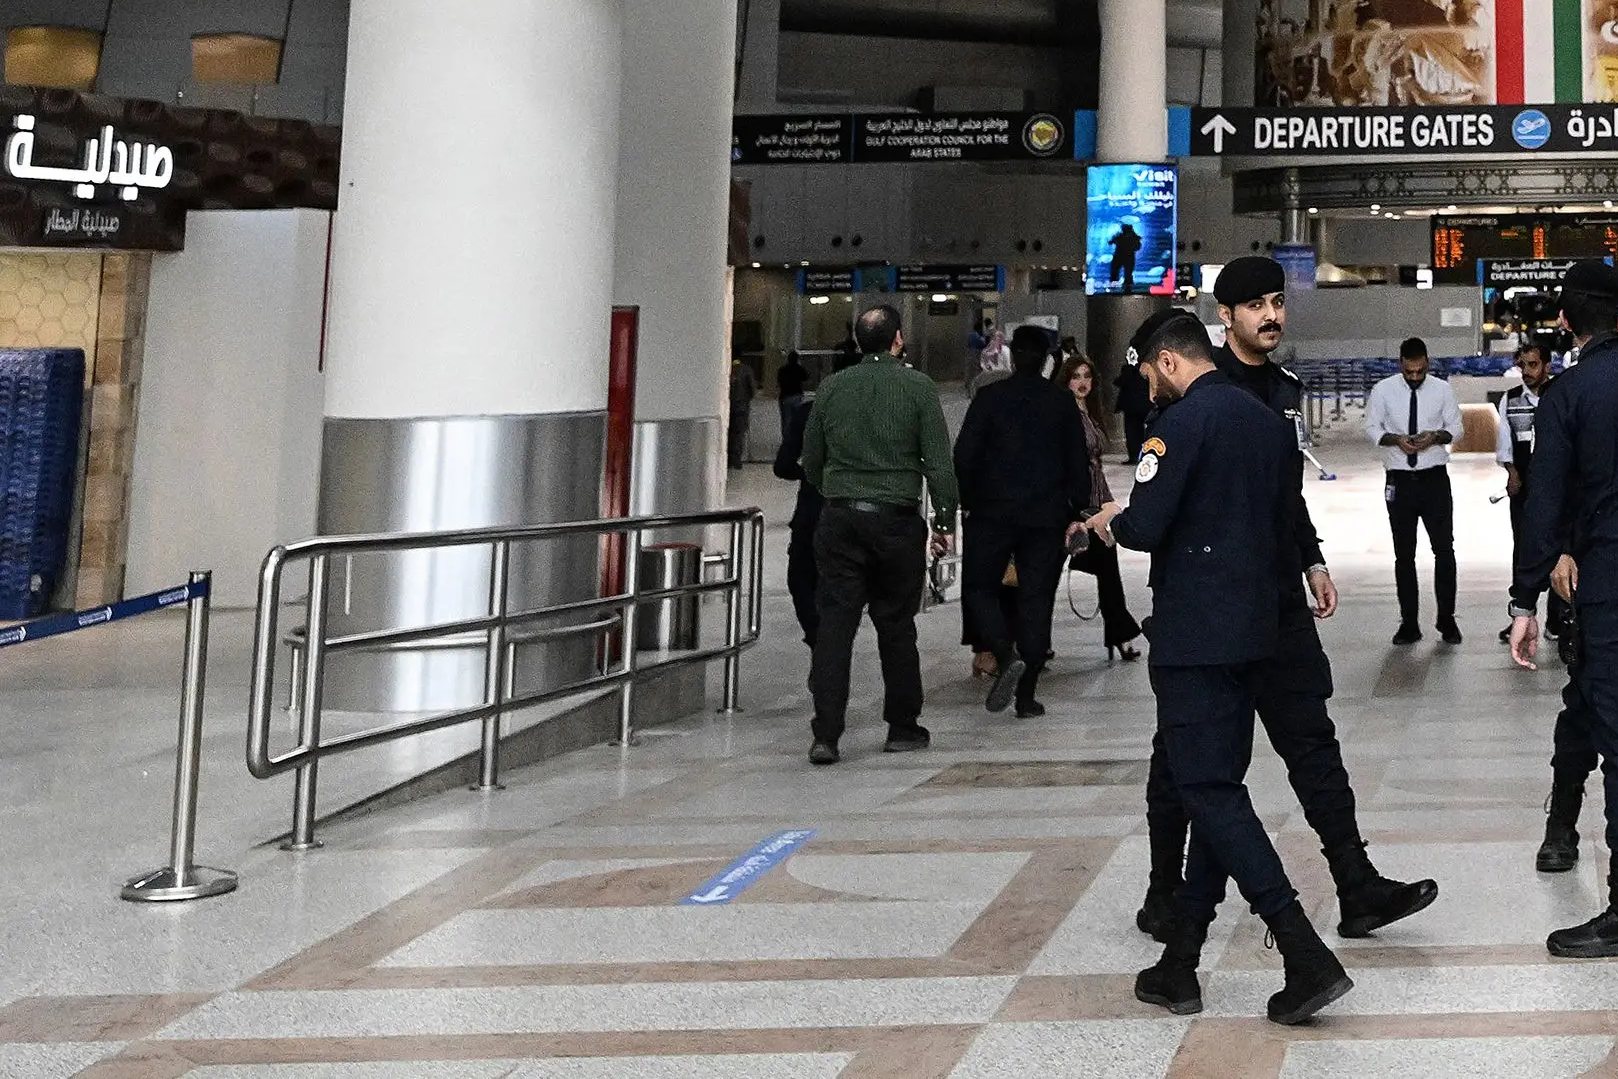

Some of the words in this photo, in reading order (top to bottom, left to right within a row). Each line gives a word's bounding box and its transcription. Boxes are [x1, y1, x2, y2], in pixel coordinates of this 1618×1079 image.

[1254, 115, 1405, 149] DEPARTURE
[1410, 113, 1494, 148] GATES
[1490, 271, 1557, 282] DEPARTURE
